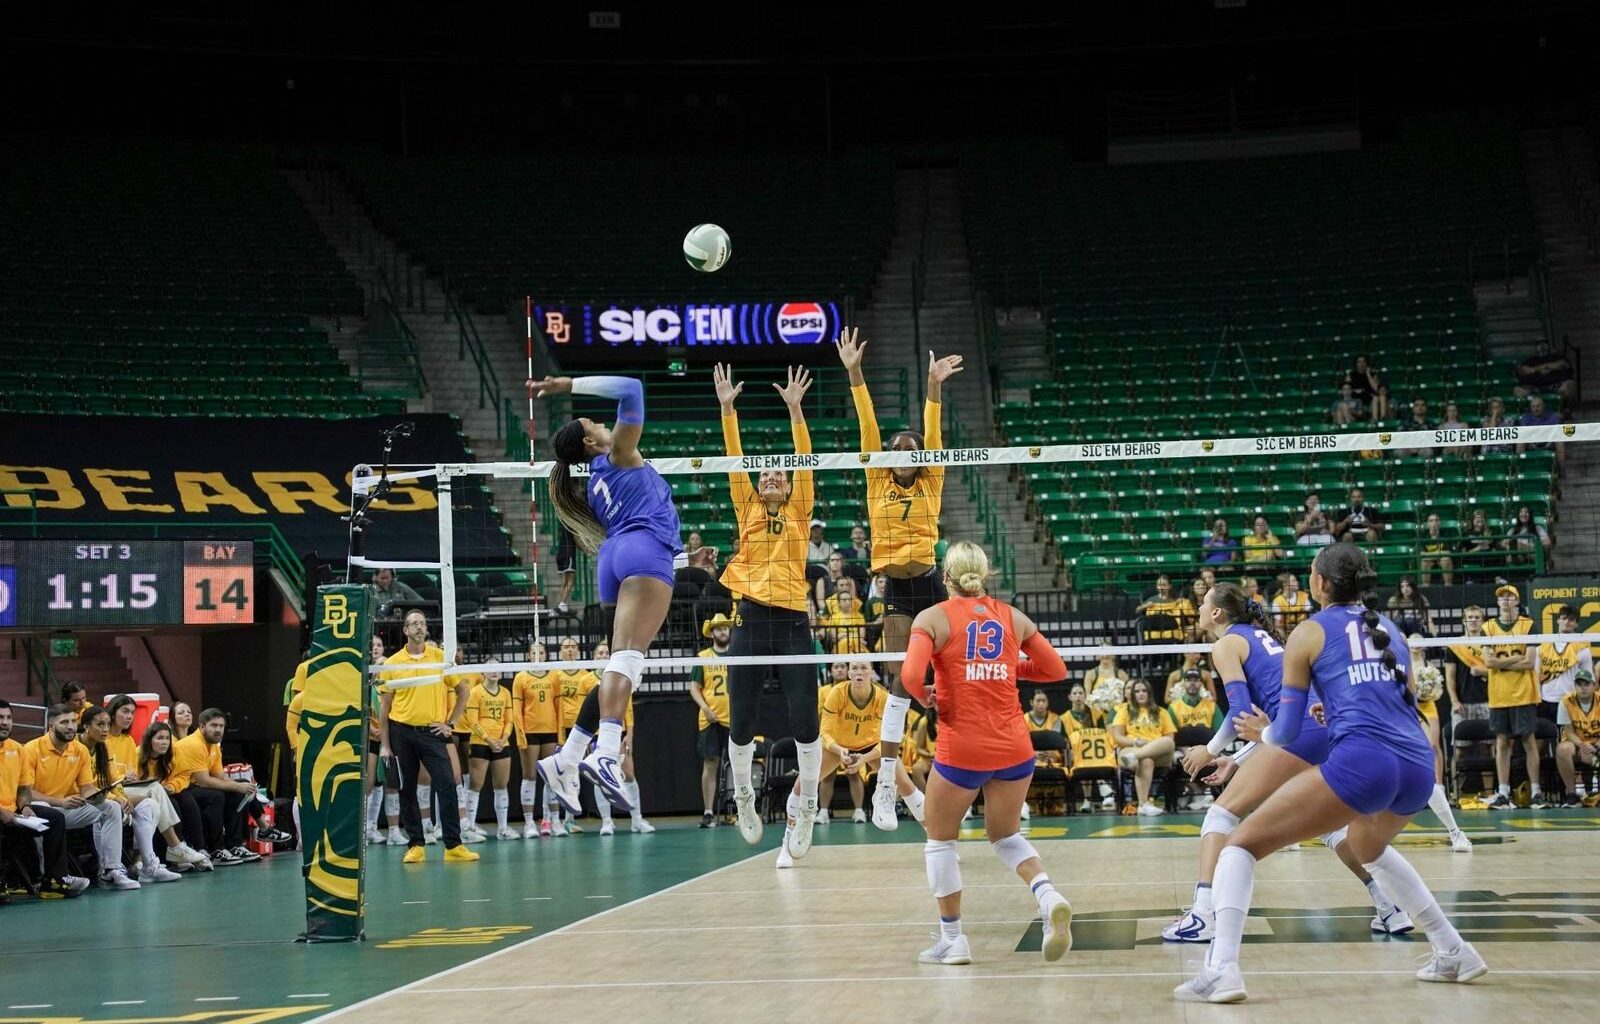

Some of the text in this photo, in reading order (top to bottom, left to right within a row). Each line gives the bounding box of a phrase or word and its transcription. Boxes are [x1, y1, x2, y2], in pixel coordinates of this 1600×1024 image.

[598, 309, 681, 342] SIC
[781, 318, 823, 329] PEPSI
[1256, 438, 1276, 451] SIC
[1299, 435, 1337, 449] BEARS
[1435, 430, 1457, 443] SIC
[1480, 427, 1519, 441] BEARS
[911, 451, 931, 463] SIC
[953, 449, 989, 462] BEARS
[1081, 445, 1102, 457] SIC
[1124, 442, 1161, 456] BEARS
[742, 456, 762, 469] SIC
[784, 454, 819, 467] BEARS
[0, 464, 438, 514] BEARS
[899, 499, 912, 521] 7
[766, 519, 784, 535] 10
[75, 545, 132, 560] SET 3
[203, 545, 236, 560] BAY
[48, 573, 158, 609] 1:15
[194, 578, 248, 610] 14
[1581, 587, 1600, 597] SER
[322, 594, 358, 639] BU
[965, 619, 1005, 662] 13
[966, 663, 1009, 681] HAYES
[539, 690, 546, 703] 8
[488, 707, 502, 720] 33
[854, 722, 860, 736] 1
[1081, 739, 1106, 760] 26
